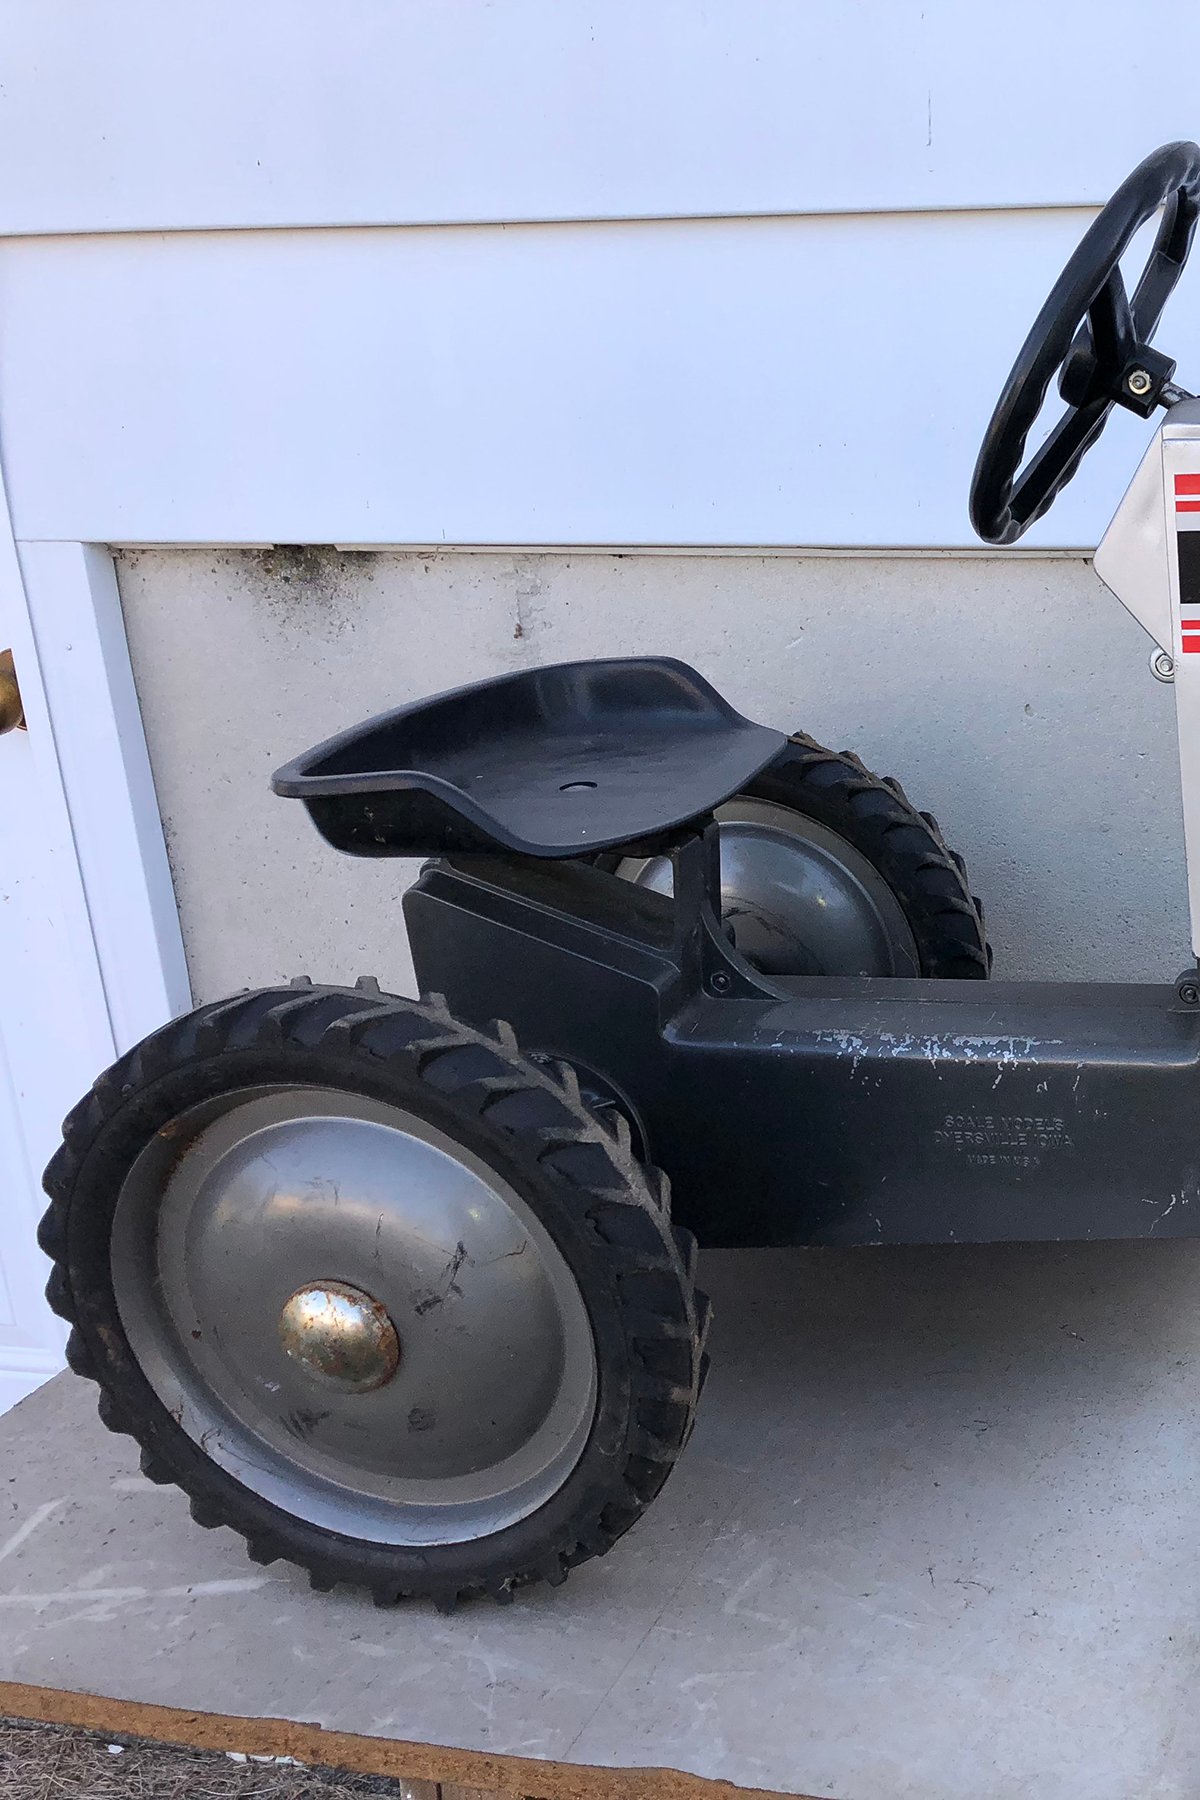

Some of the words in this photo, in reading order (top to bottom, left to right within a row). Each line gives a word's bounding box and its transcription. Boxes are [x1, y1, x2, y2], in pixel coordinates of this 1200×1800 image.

[944, 1115, 995, 1129] SCALE
[1001, 1117, 1065, 1131] MODELS
[1034, 1133, 1074, 1147] IOWA
[967, 1154, 997, 1165] MADE
[999, 1154, 1010, 1165] IN
